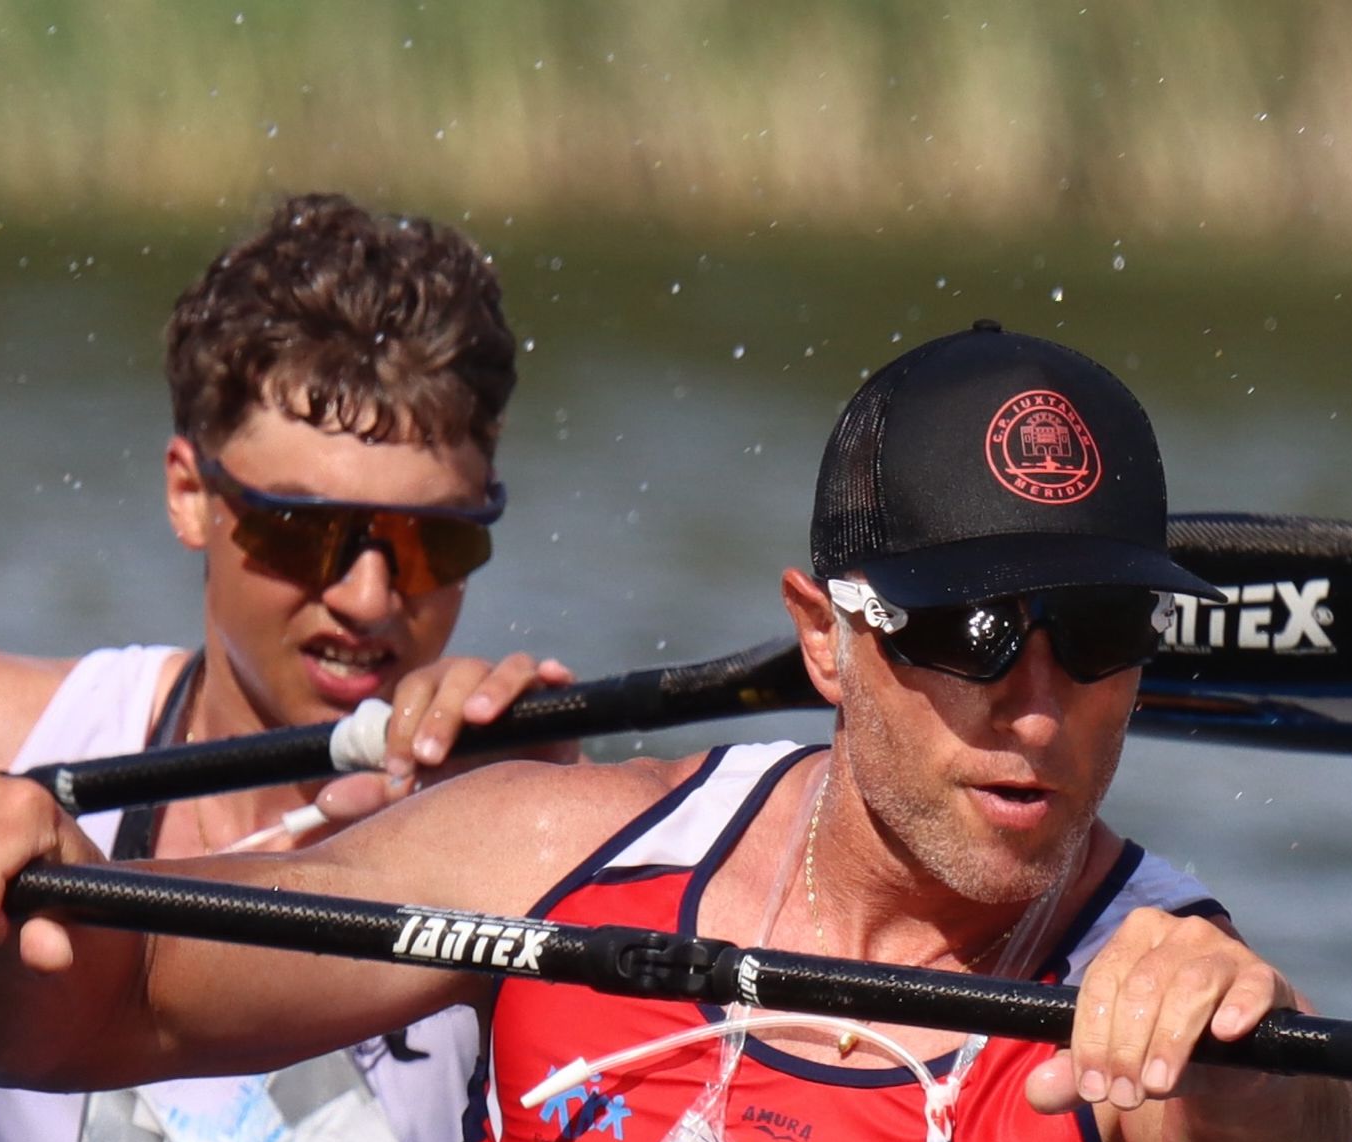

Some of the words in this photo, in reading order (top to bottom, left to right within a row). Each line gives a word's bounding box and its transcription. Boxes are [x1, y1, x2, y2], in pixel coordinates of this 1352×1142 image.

[1014, 477, 1086, 498] MERIDA
[1163, 578, 1333, 649] NTEX
[393, 915, 550, 971] JANTEX
[742, 1105, 813, 1142] AMURA
